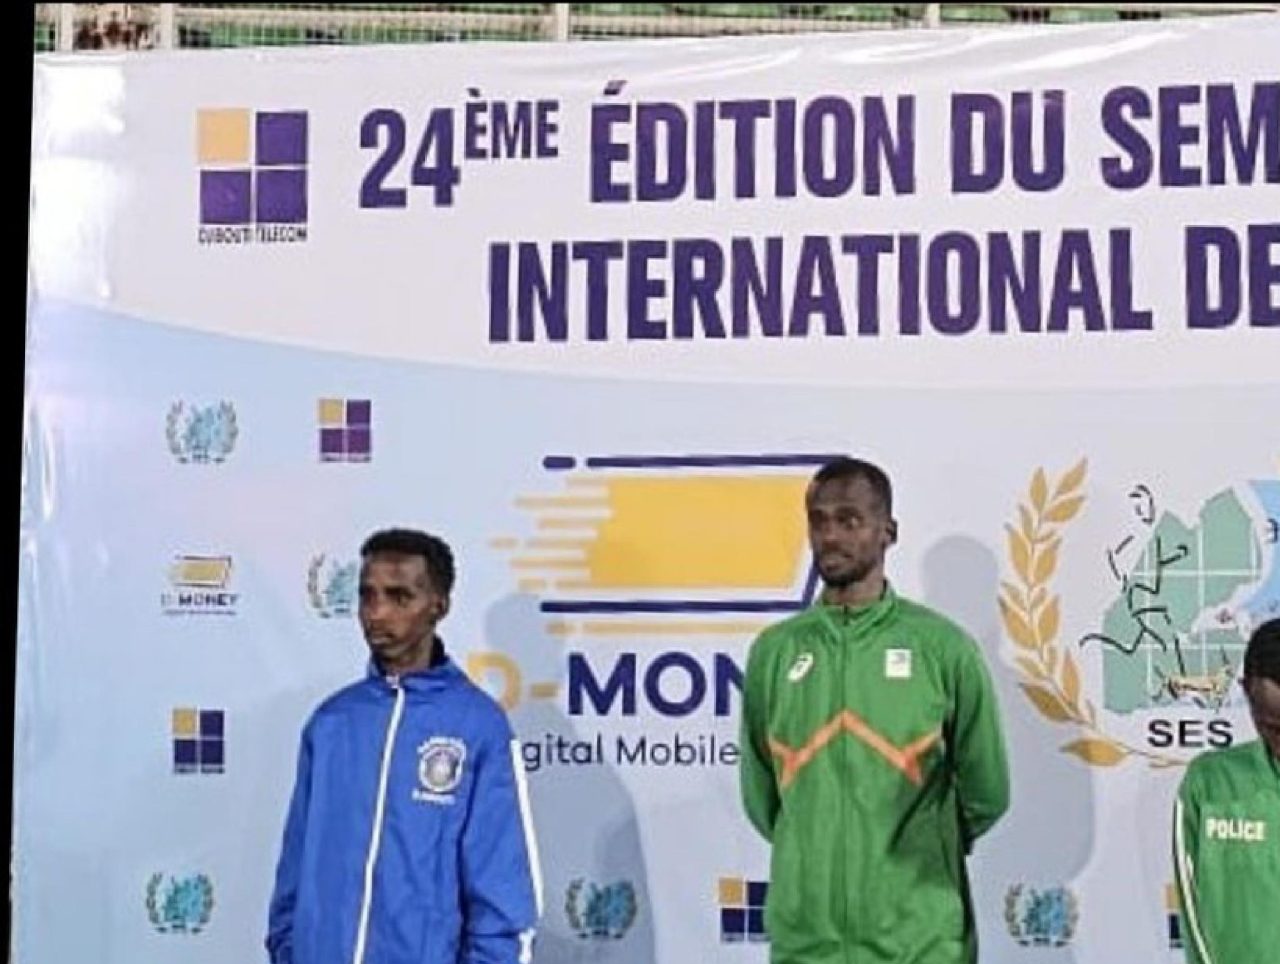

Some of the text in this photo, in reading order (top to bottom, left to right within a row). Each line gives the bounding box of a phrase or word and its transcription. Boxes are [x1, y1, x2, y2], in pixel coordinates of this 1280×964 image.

[590, 80, 916, 203] ÉDITION
[950, 90, 1067, 194] DU
[487, 228, 1153, 344] INTERNATIONAL
[616, 734, 741, 767] Mobile
[1147, 719, 1235, 749] SES
[1205, 817, 1266, 842] POLICE
